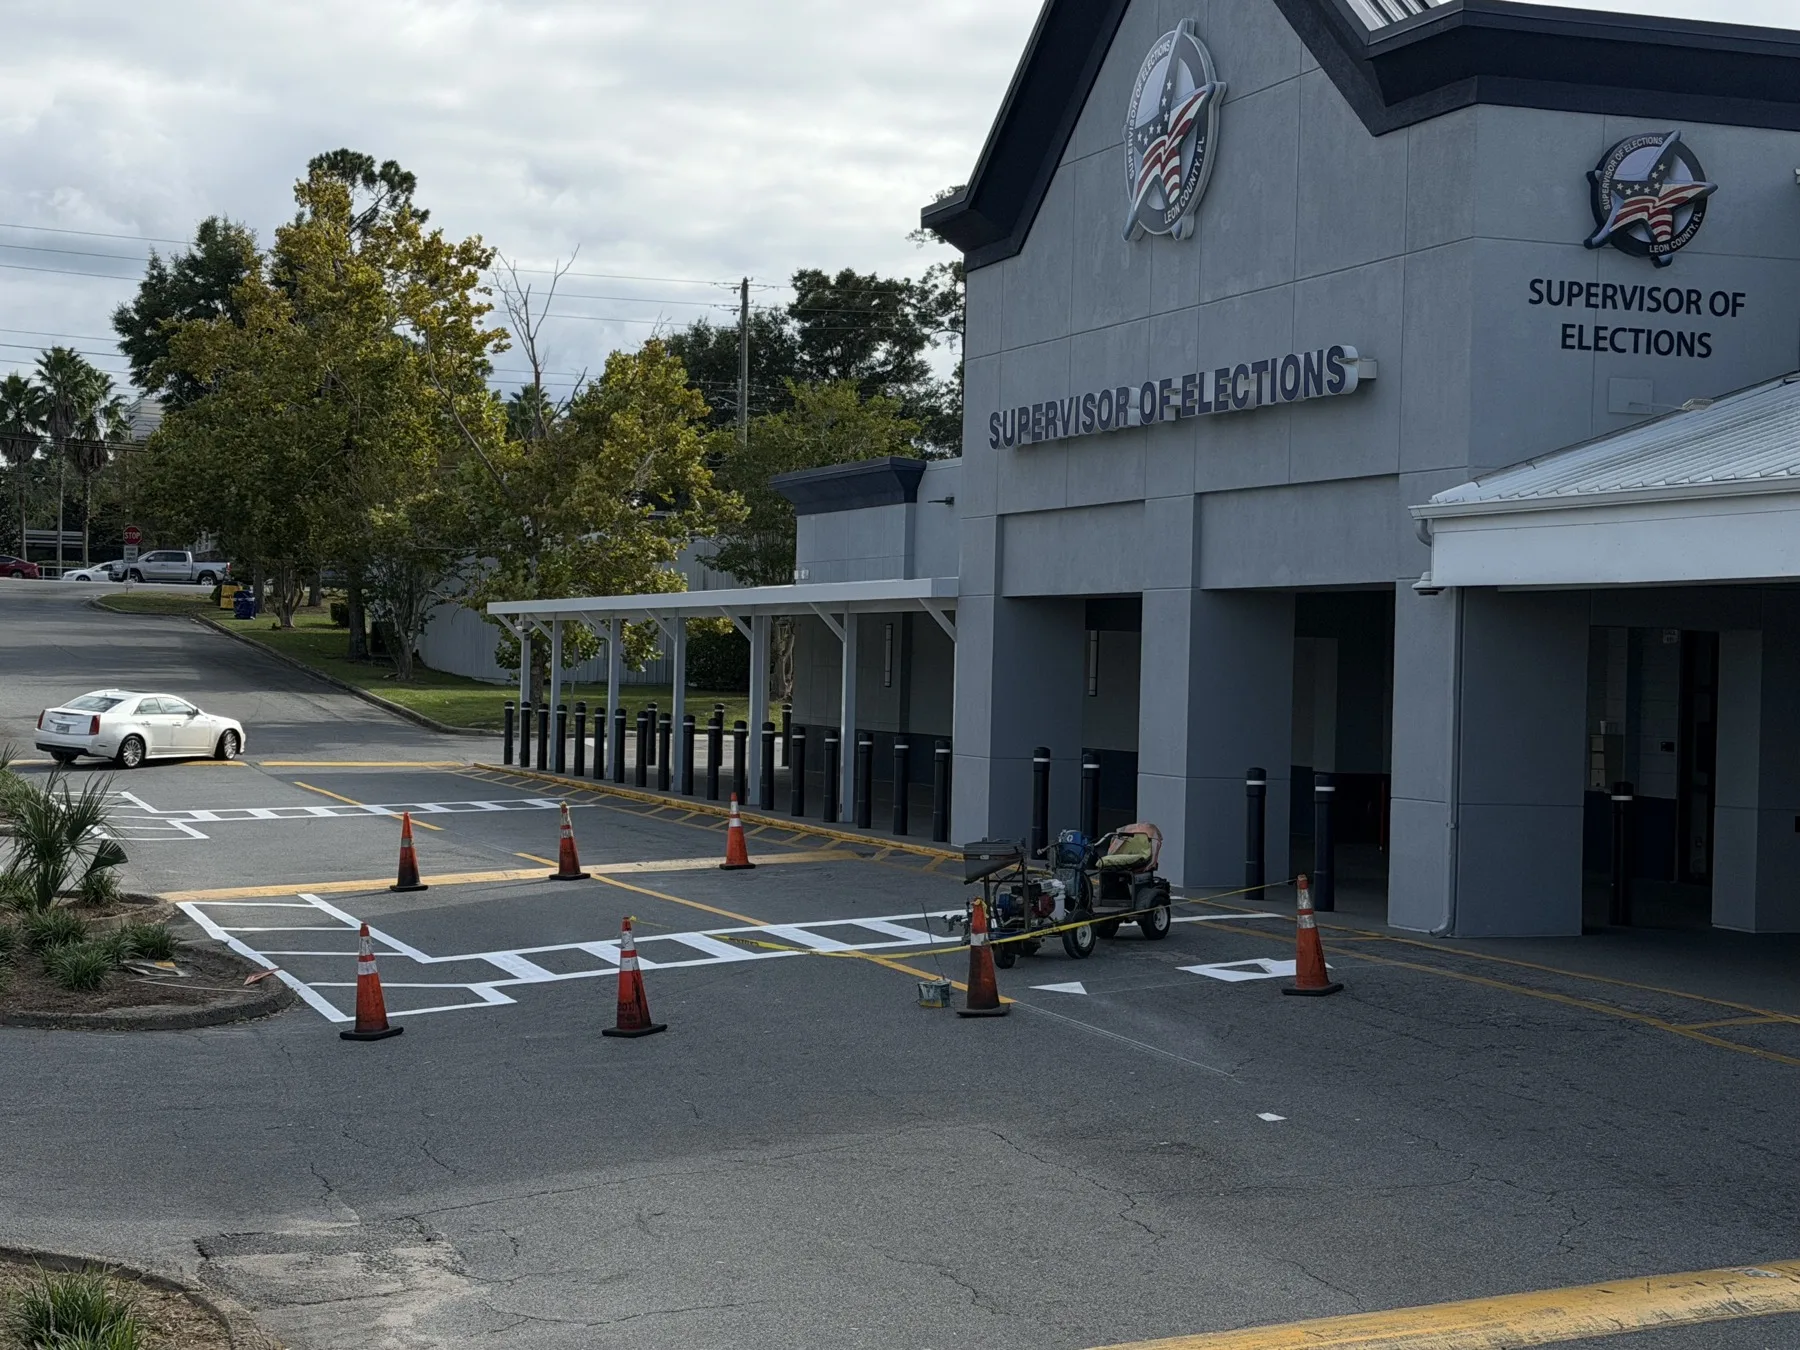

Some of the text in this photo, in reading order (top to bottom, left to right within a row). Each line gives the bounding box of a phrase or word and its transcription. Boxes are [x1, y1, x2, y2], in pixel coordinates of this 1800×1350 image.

[1127, 40, 1171, 179] SUPERVISOR OF ELECTIONS
[1163, 136, 1206, 224] LEON COUNTY, FL
[1601, 136, 1663, 210] SUPERVISOR OF ELECTIONS
[1649, 212, 1702, 253] LEON COUNTY, FL
[1528, 278, 1746, 317] SUPERVISOR OF
[1561, 323, 1712, 359] ELECTIONS
[989, 345, 1352, 450] SUPERVISOR OF ELECTIONS
[124, 531, 141, 540] STOP
